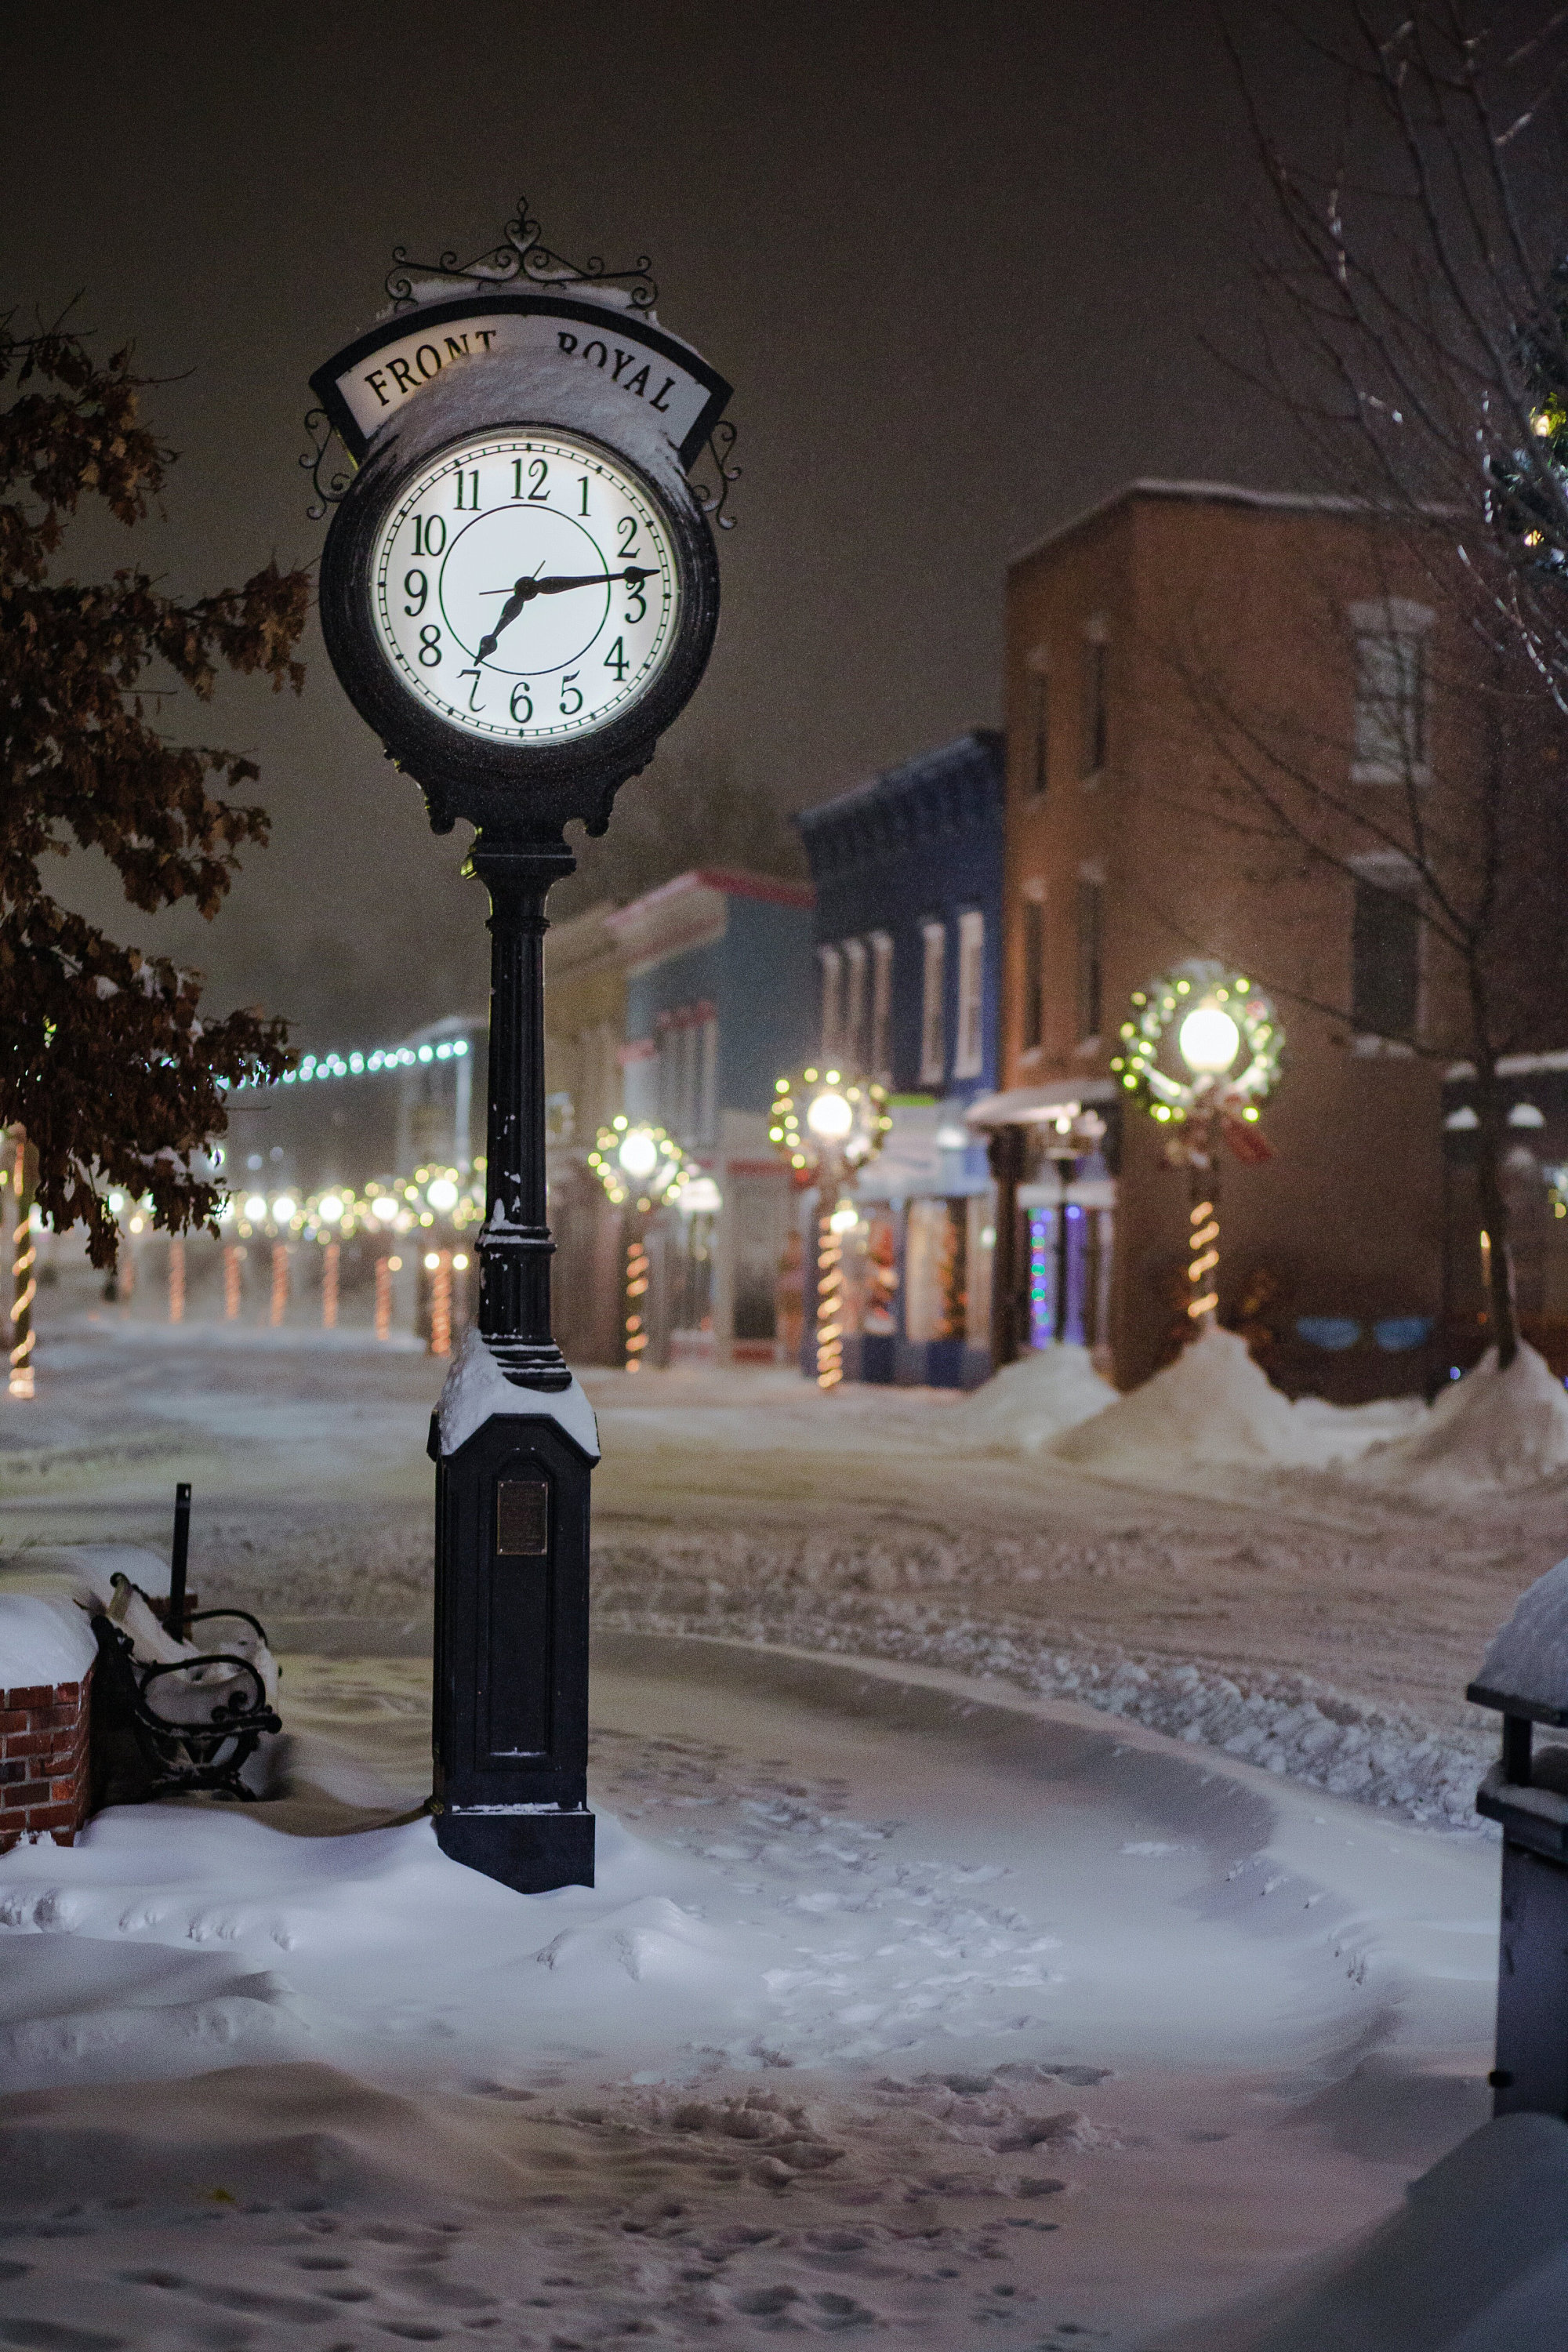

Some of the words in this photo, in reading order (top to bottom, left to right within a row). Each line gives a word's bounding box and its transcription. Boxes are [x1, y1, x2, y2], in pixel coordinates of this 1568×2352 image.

[365, 330, 497, 406] FRONT
[453, 470, 482, 510] 11
[510, 459, 550, 500] 12
[578, 476, 591, 517] 1
[411, 514, 446, 556] 10
[616, 516, 641, 558] 2
[404, 568, 428, 617] 9
[624, 575, 647, 623] 3
[419, 624, 442, 667] 8
[603, 636, 630, 682] 4
[456, 670, 486, 712] 7
[510, 681, 532, 723] 6
[559, 670, 583, 714] 5
